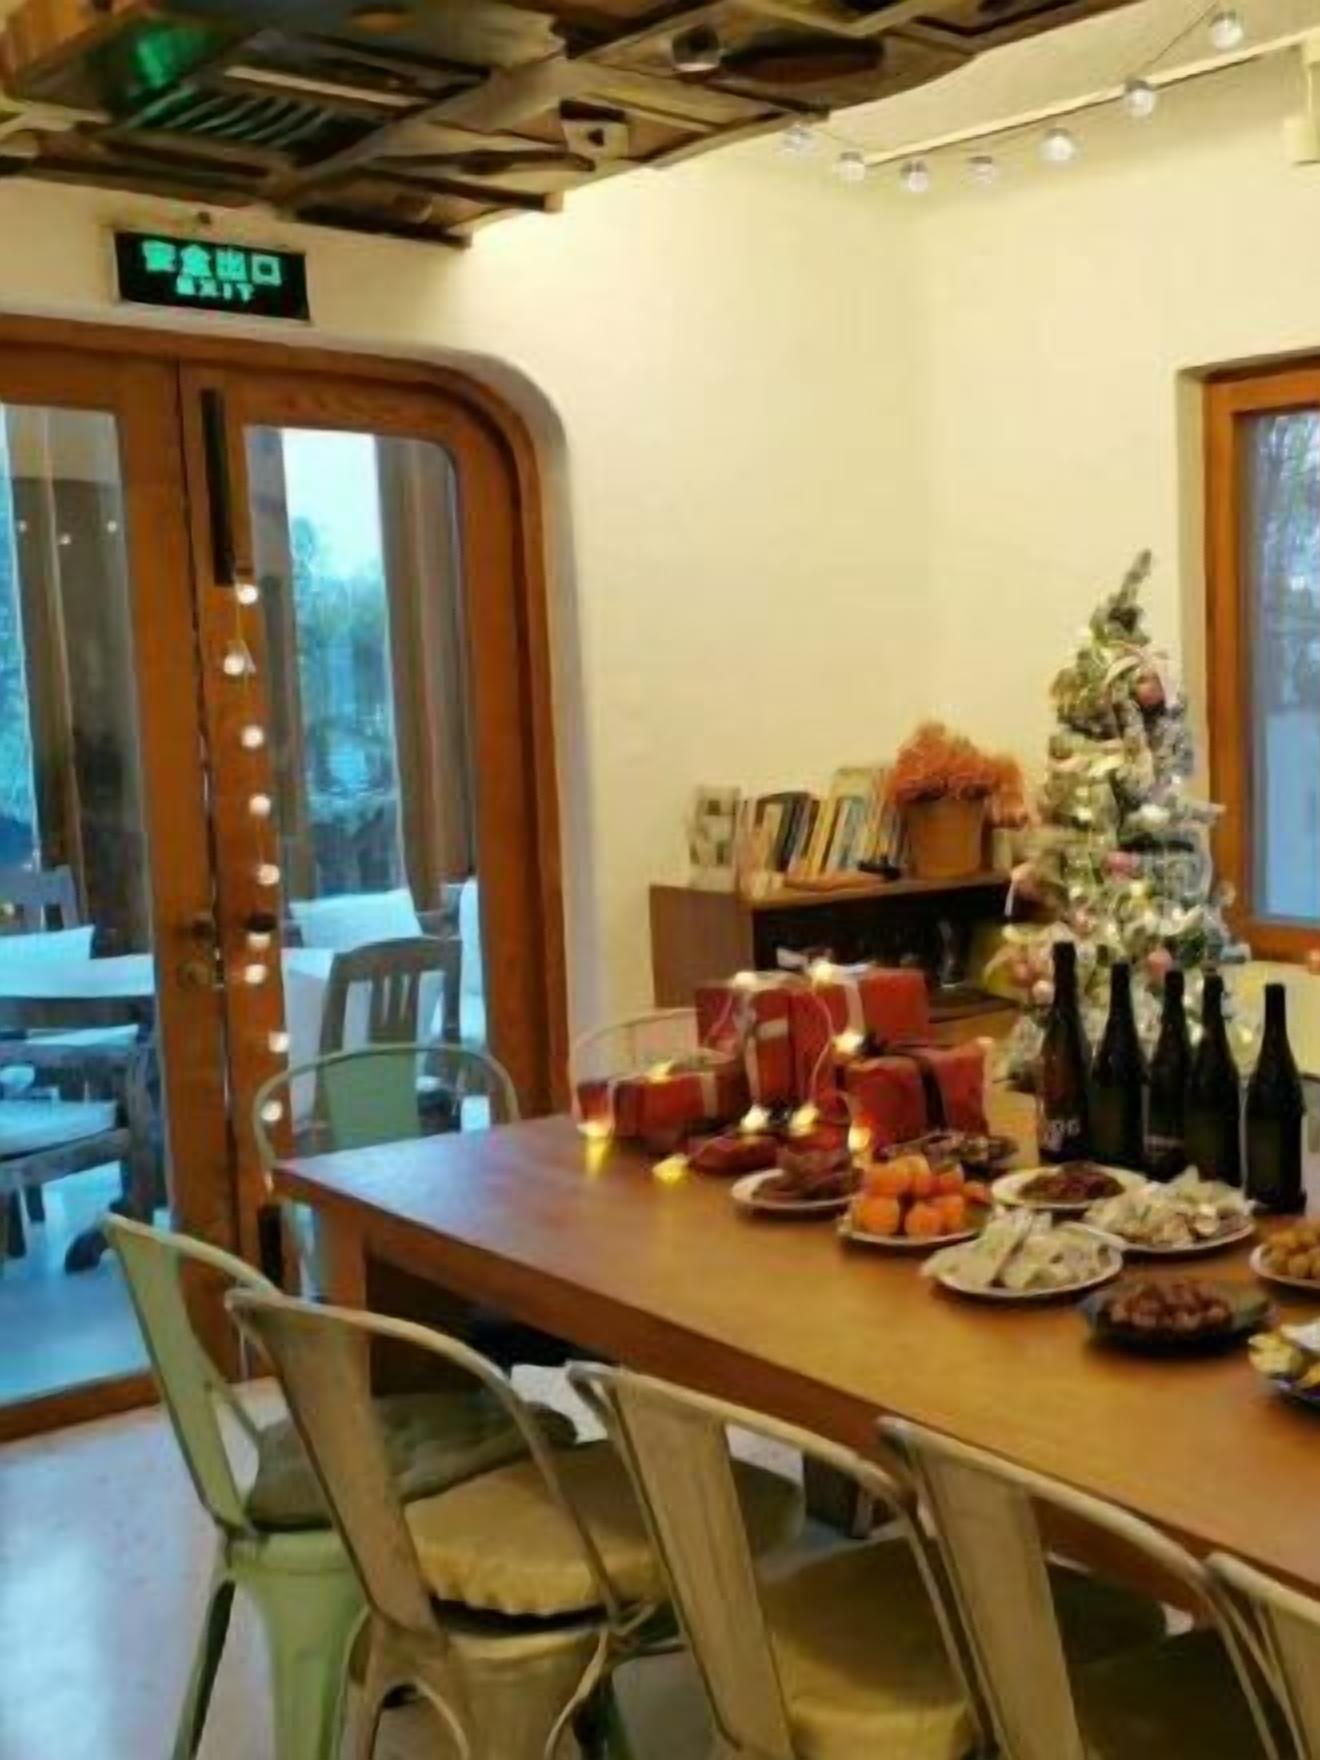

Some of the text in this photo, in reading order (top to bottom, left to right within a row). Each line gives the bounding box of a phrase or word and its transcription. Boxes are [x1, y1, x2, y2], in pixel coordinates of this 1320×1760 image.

[142, 240, 281, 286] 安全出口
[176, 275, 254, 302] EXIT
